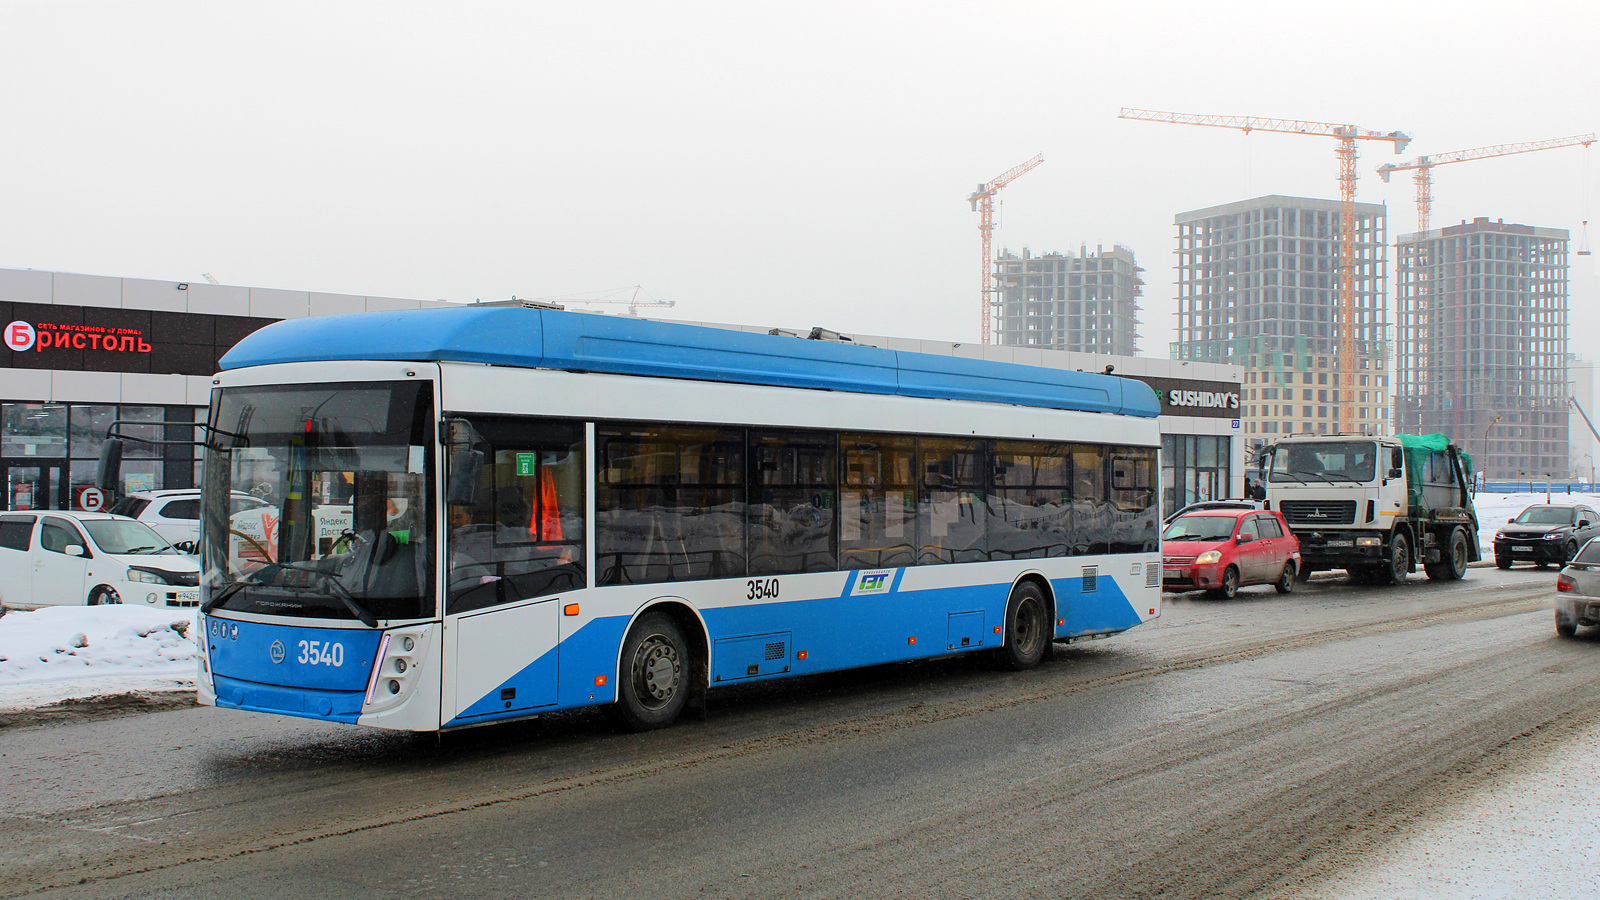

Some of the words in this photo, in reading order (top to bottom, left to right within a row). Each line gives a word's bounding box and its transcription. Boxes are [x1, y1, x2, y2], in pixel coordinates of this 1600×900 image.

[59, 324, 106, 333] МАГАЗИНОВ
[1169, 389, 1239, 409] SUSHIDAY'S
[1232, 420, 1239, 428] 27
[86, 492, 99, 507] Б
[320, 517, 348, 526] Яндекс
[747, 578, 779, 600] 3540
[298, 640, 344, 667] 3540
